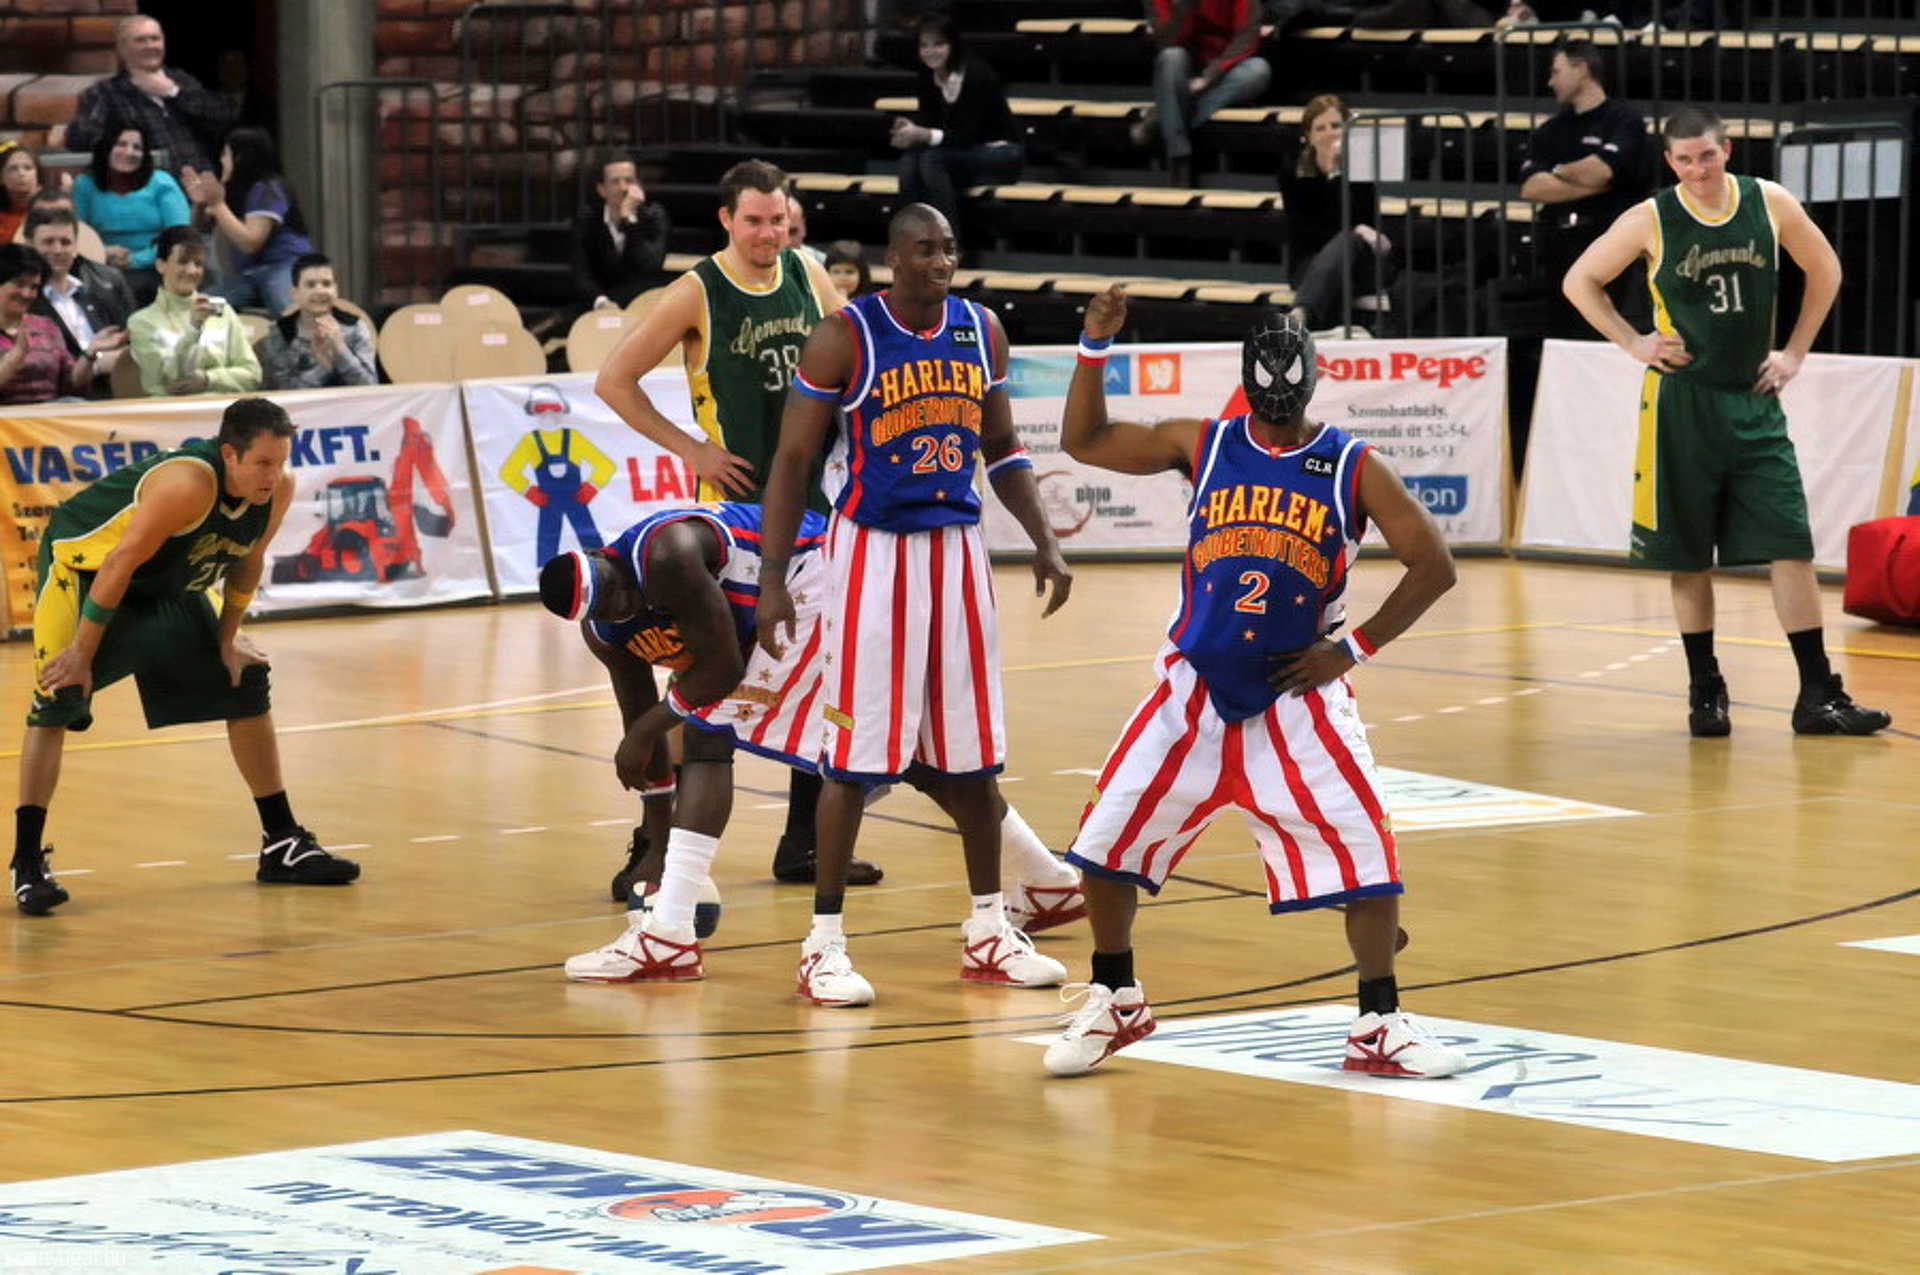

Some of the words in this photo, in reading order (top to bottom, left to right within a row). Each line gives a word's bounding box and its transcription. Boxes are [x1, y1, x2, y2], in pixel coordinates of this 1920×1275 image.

[1706, 272, 1744, 313] 31
[880, 359, 983, 409] HARLEM
[1390, 352, 1487, 388] Pepe
[870, 396, 981, 447] GLOBETROTTE
[290, 425, 381, 467] KFT.
[912, 433, 964, 474] 26
[1305, 458, 1333, 474] CLR
[1207, 484, 1329, 544] HARLEM
[1192, 526, 1331, 589] GLOBETROTTERS
[1235, 570, 1271, 614] 2
